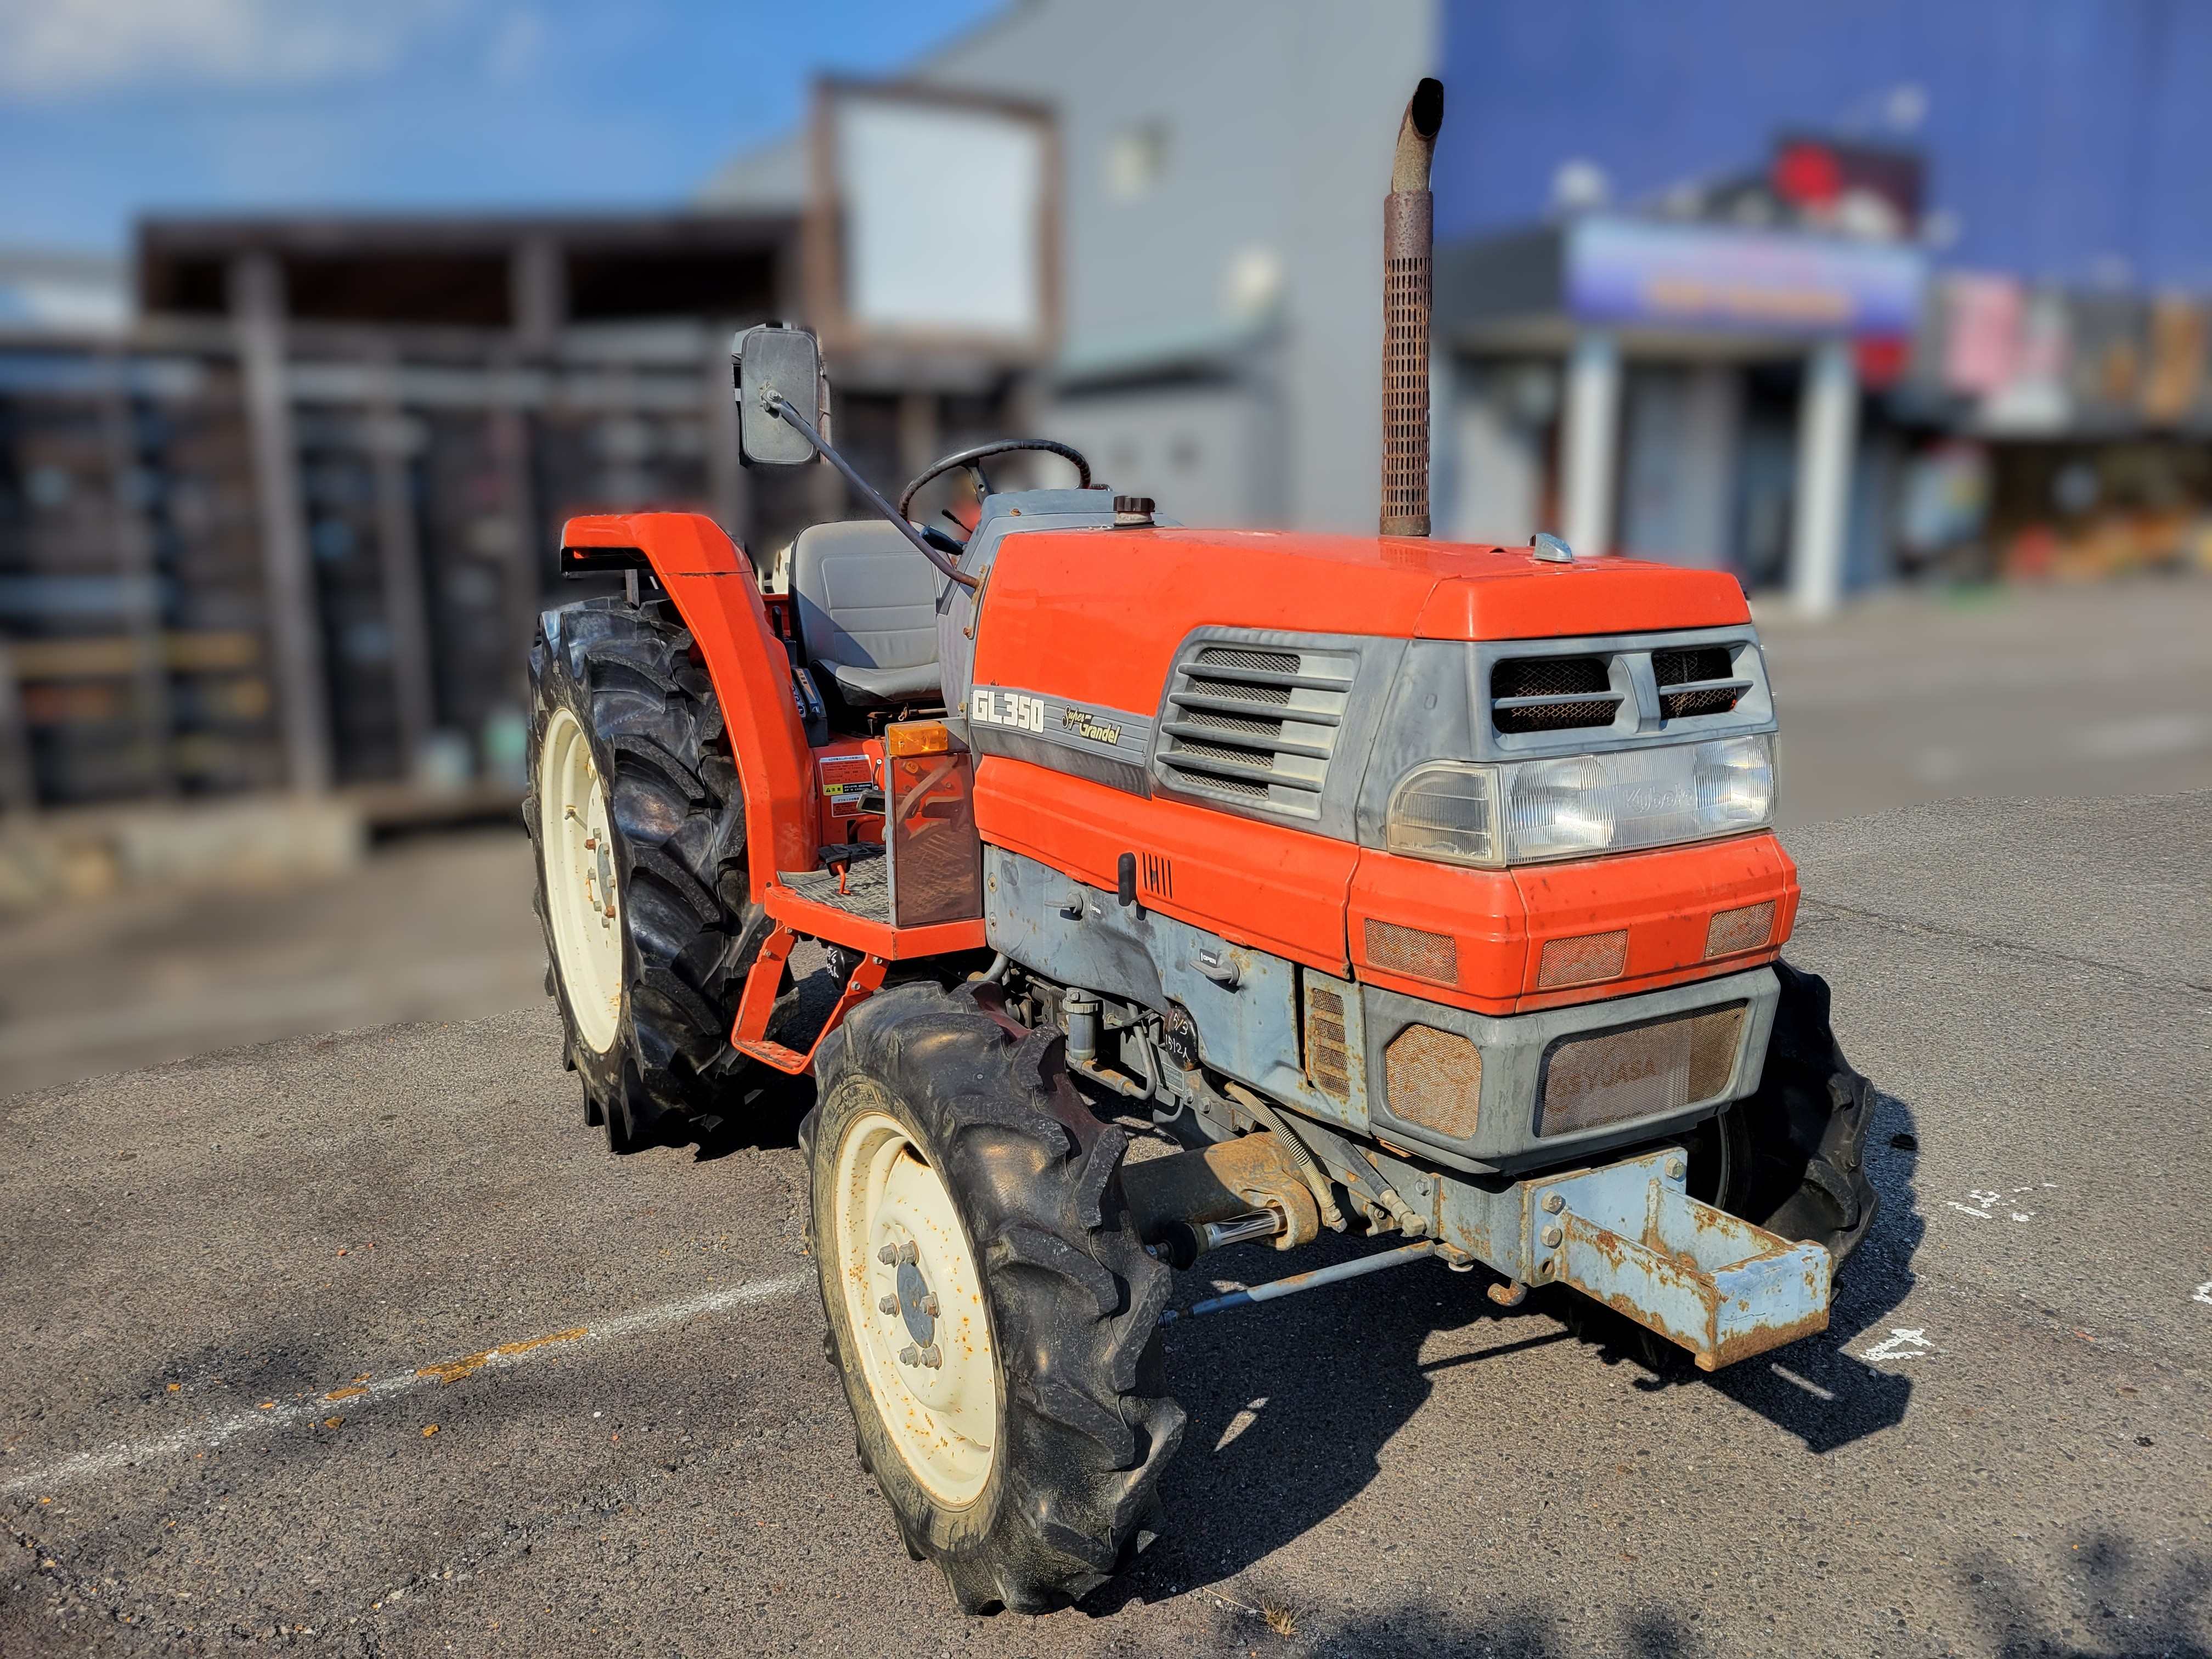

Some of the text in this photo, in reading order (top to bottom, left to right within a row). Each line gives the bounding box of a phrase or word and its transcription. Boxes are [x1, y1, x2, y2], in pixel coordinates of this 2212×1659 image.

[972, 690, 1044, 733] GL350
[1062, 705, 1087, 730] Super
[1079, 715, 1121, 744] Grandel
[1623, 782, 1696, 814] Kubota
[1203, 955, 1216, 964] OPEN
[1173, 1013, 1188, 1035] 5/3
